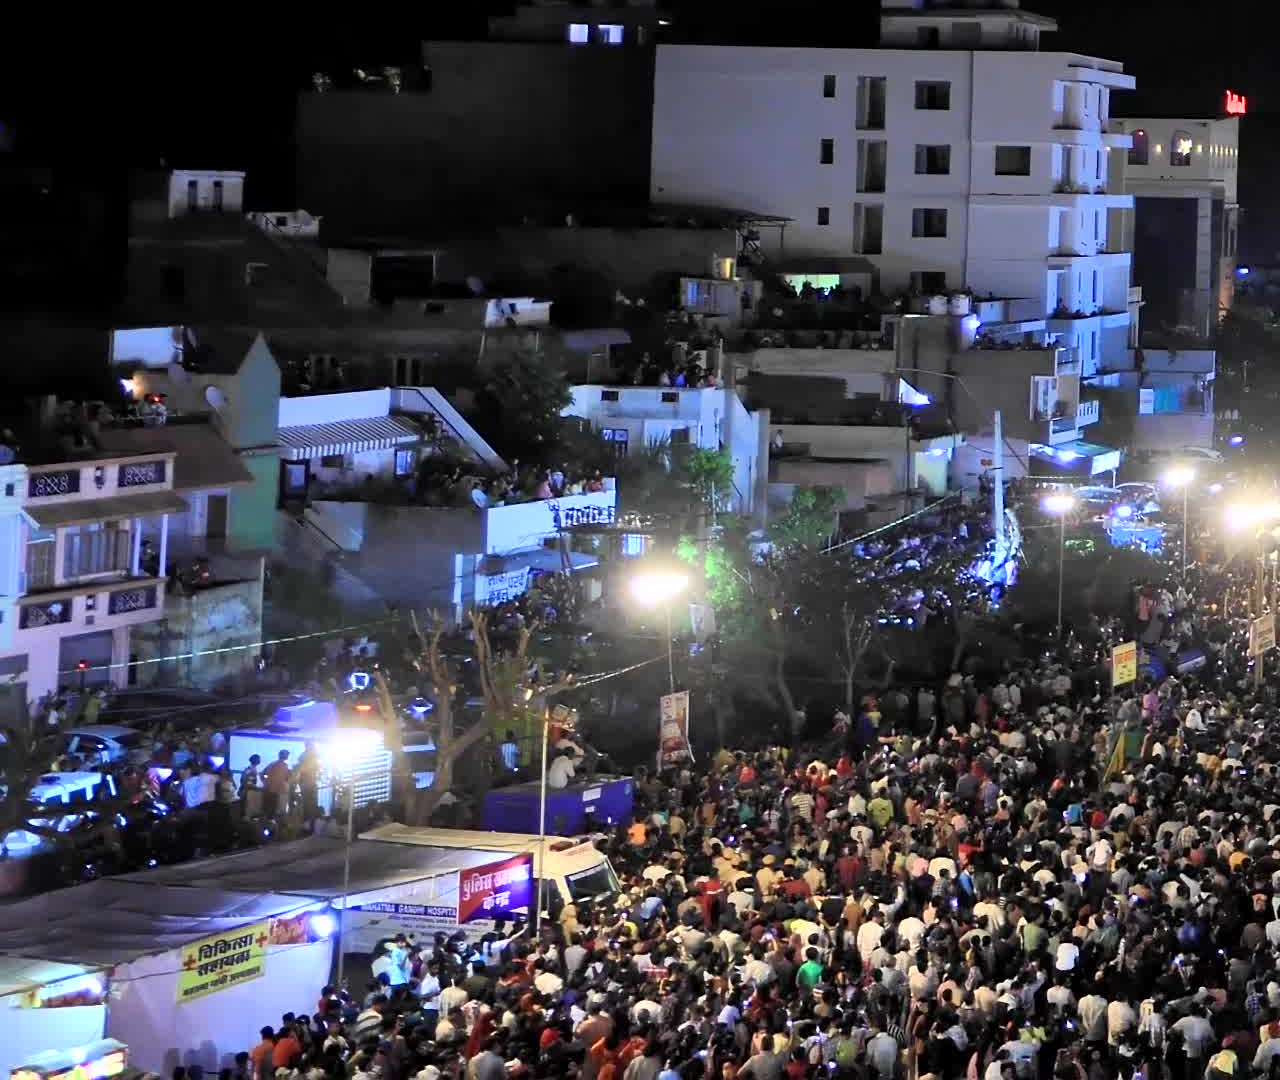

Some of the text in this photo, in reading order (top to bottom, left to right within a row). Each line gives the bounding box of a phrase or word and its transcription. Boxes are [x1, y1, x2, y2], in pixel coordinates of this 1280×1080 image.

[463, 873, 493, 901] पुलिस
[398, 905, 425, 915] GANDHI
[427, 907, 458, 918] HOSPITA
[198, 933, 255, 962] चिकित्सा
